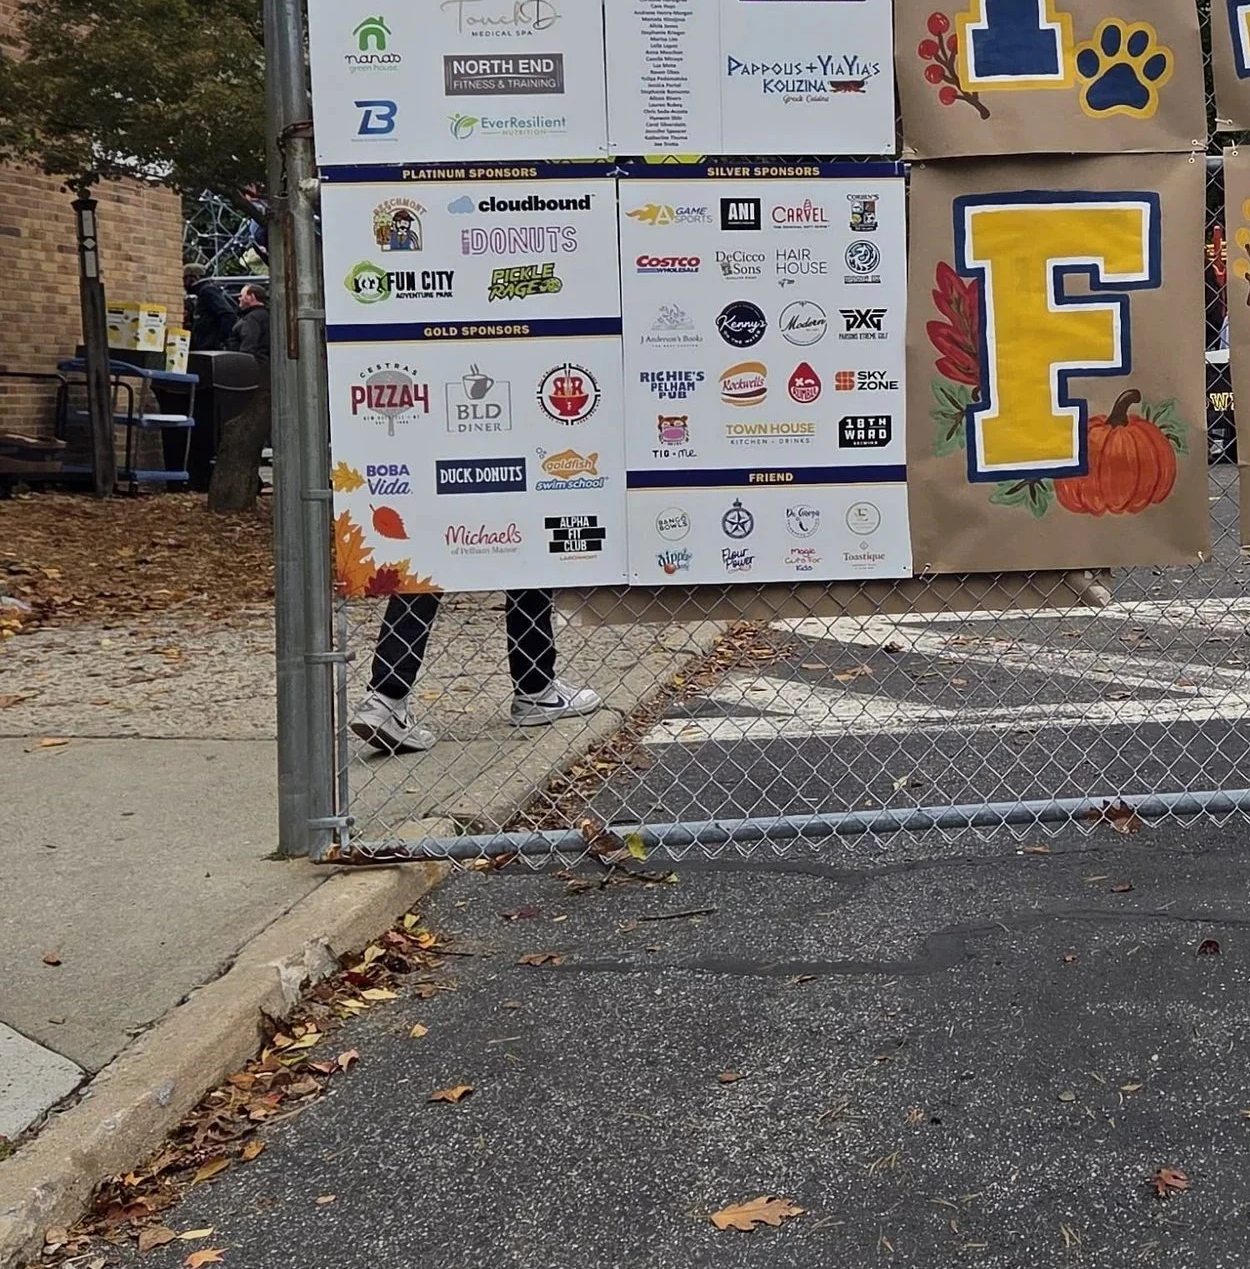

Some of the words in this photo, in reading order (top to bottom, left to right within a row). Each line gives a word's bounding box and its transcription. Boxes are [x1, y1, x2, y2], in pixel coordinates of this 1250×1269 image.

[453, 59, 513, 74] NORTH
[518, 59, 554, 73] END
[453, 79, 495, 89] FITNESS
[497, 79, 505, 88] &
[508, 78, 556, 88] TRAINING
[763, 79, 828, 93] KOUZINA
[481, 116, 566, 128] EverResilient
[402, 168, 466, 180] PLATINUM
[469, 167, 537, 178] SPONSORS
[707, 166, 750, 177] SILVER
[754, 166, 820, 177] SPONSORS
[478, 195, 591, 212] cloudbound
[675, 207, 708, 215] GAME
[728, 202, 755, 220] ANI
[772, 205, 829, 223] CARVEL
[674, 215, 713, 223] SPORTS
[471, 226, 578, 255] DONUTS
[715, 251, 766, 263] DeCicco
[776, 248, 812, 261] HAIR
[636, 255, 701, 267] COSTCO
[491, 262, 556, 284] PICKLE
[733, 262, 762, 275] Sons
[776, 261, 828, 274] HOUSE
[386, 271, 416, 292] FUN
[421, 271, 455, 291] CITY
[424, 327, 457, 337] GOLD
[462, 325, 530, 336] SPONSORS
[640, 371, 705, 383] RICHIE'S
[858, 371, 887, 380] SKY
[651, 382, 696, 392] PELHAM
[858, 381, 898, 390] ZONE
[659, 391, 687, 399] PUB
[456, 403, 502, 420] BLD
[458, 423, 502, 432] DINER
[726, 423, 768, 435] TOWN
[770, 422, 815, 434] HOUSE
[844, 429, 888, 440] WARD
[366, 464, 410, 476] BOBA
[546, 458, 593, 472] goldfish
[440, 468, 473, 483] DUCK
[476, 466, 523, 482] DONUTS
[749, 473, 794, 483] FRIEND
[536, 480, 566, 490] swim
[560, 517, 589, 528] ALPHA
[568, 529, 582, 539] FIT
[564, 541, 587, 552] CLUB
[843, 552, 886, 562] Toastique
